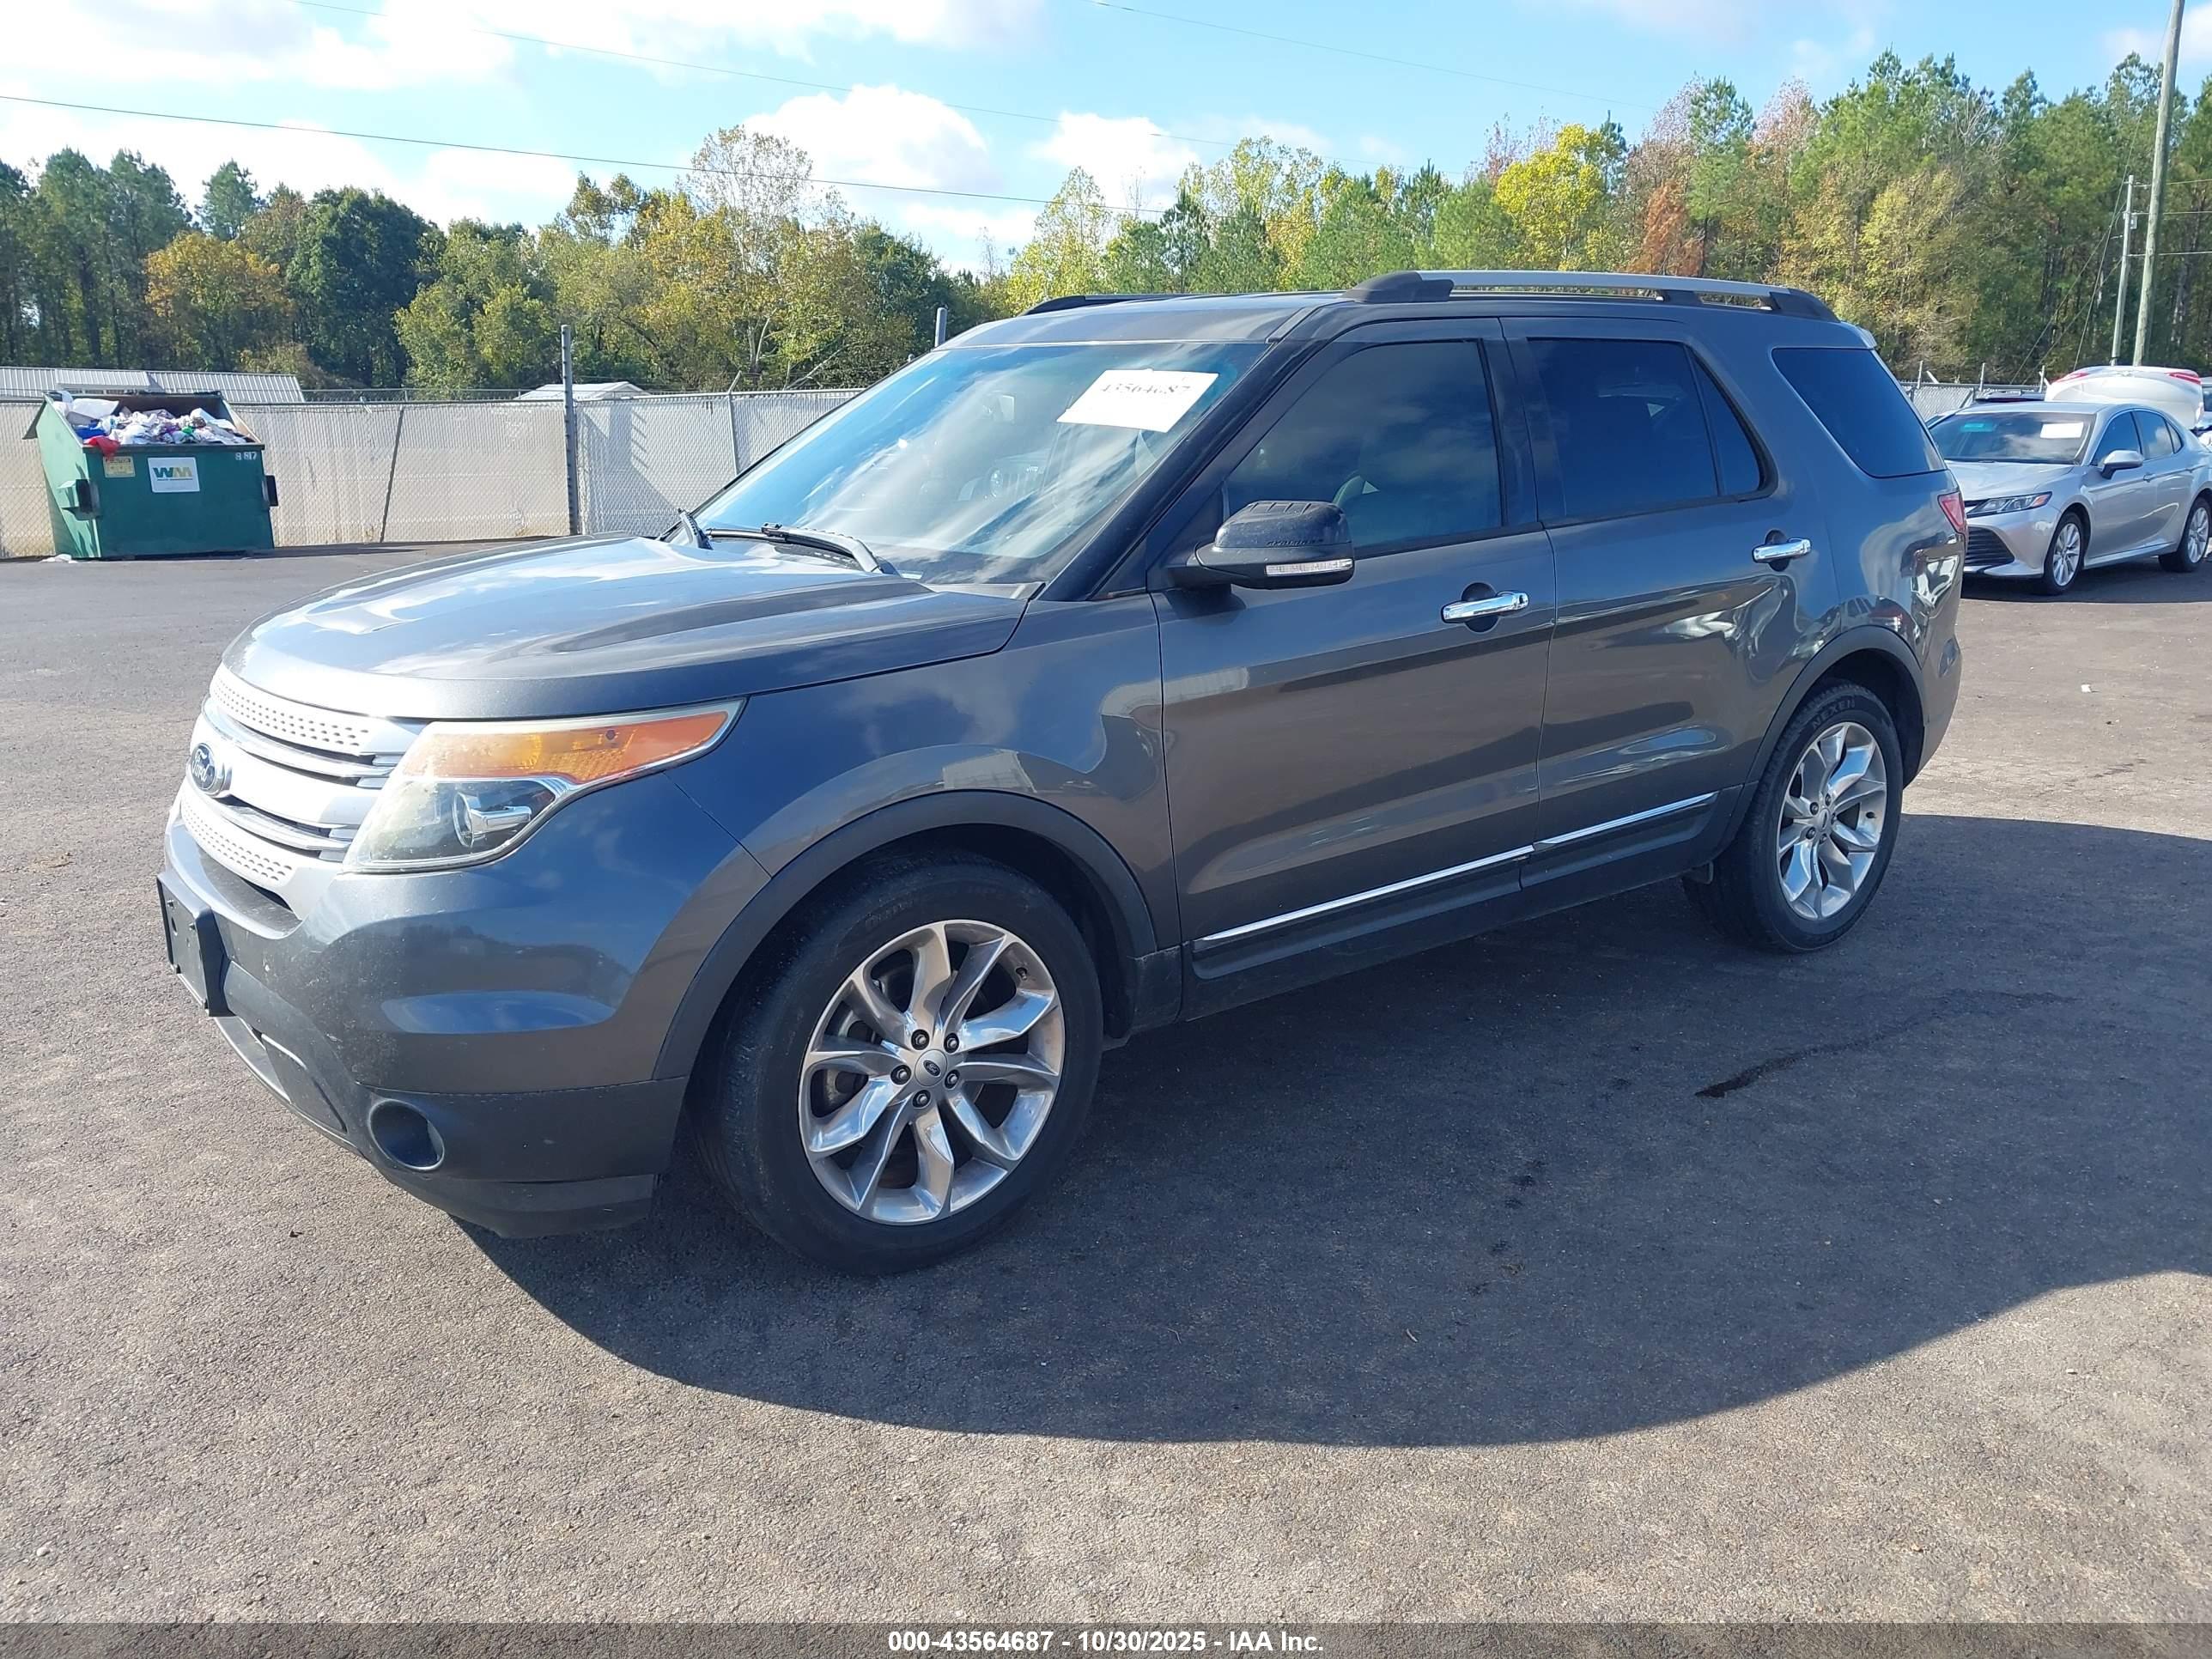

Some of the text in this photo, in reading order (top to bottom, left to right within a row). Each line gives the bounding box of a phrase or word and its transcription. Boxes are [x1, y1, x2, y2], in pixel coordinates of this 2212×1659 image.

[152, 466, 193, 478] WM
[1813, 699, 1856, 730] NEXEN
[191, 748, 210, 782] Ford
